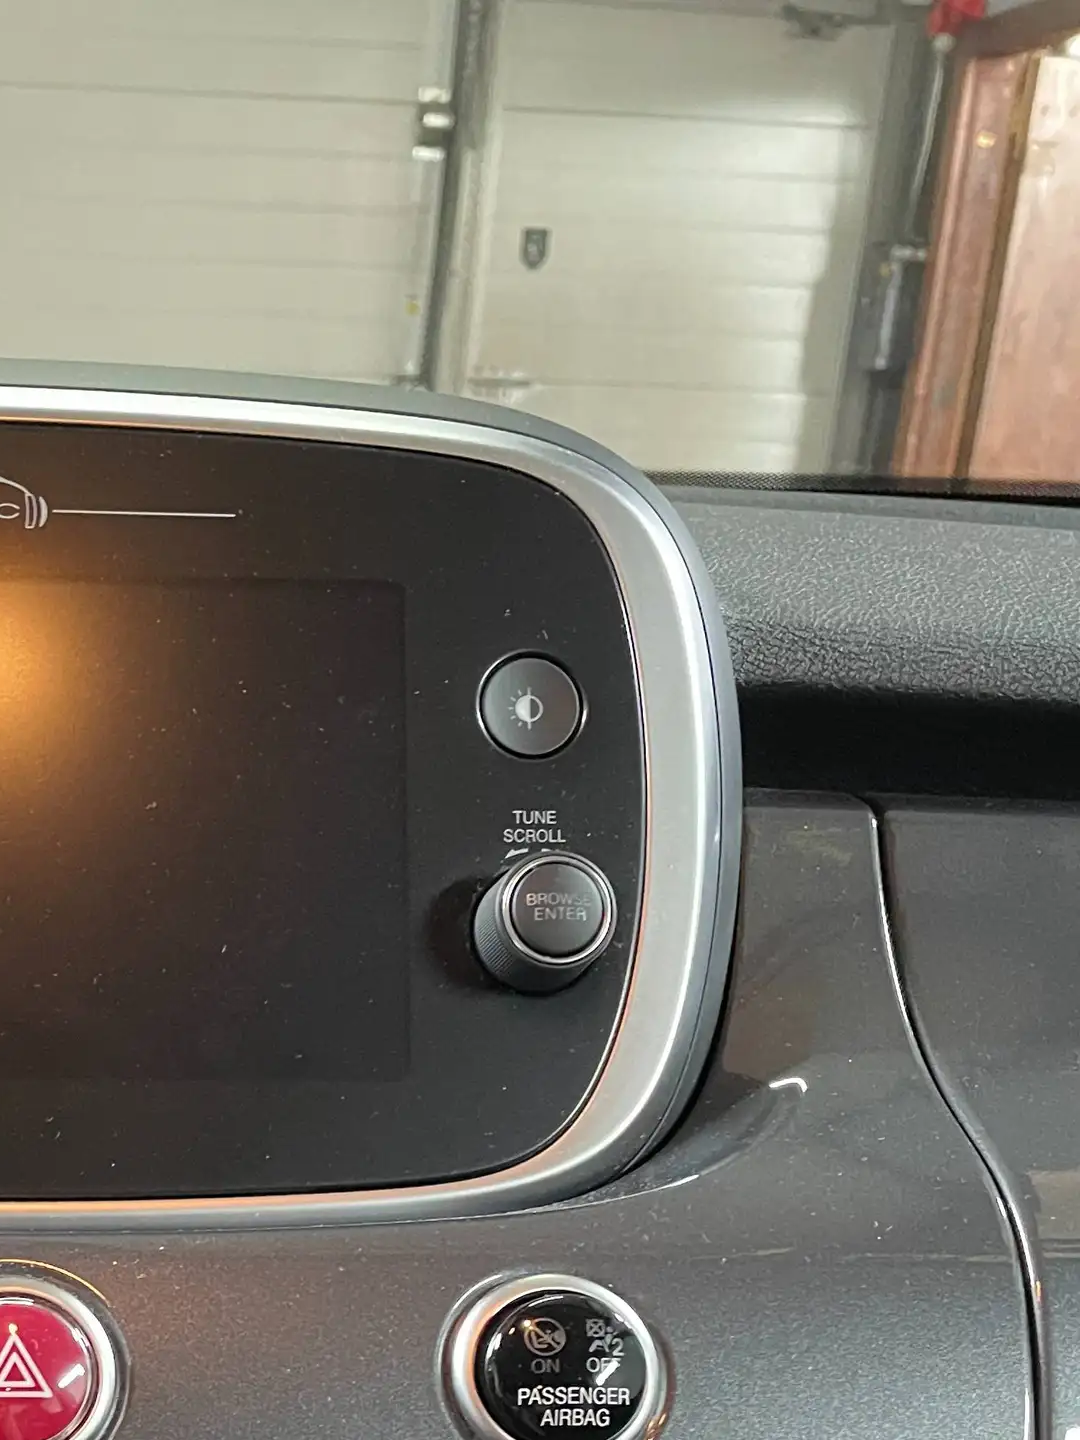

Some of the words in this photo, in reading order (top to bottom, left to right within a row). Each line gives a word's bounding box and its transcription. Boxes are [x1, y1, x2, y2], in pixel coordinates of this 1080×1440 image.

[512, 810, 557, 825] TUNE
[503, 829, 566, 843] SCROLL
[526, 892, 591, 906] BROWSE
[534, 906, 587, 921] ENTER
[530, 1358, 560, 1374] ON
[517, 1386, 631, 1406] PASSENGER
[540, 1408, 611, 1427] AIRBAG
